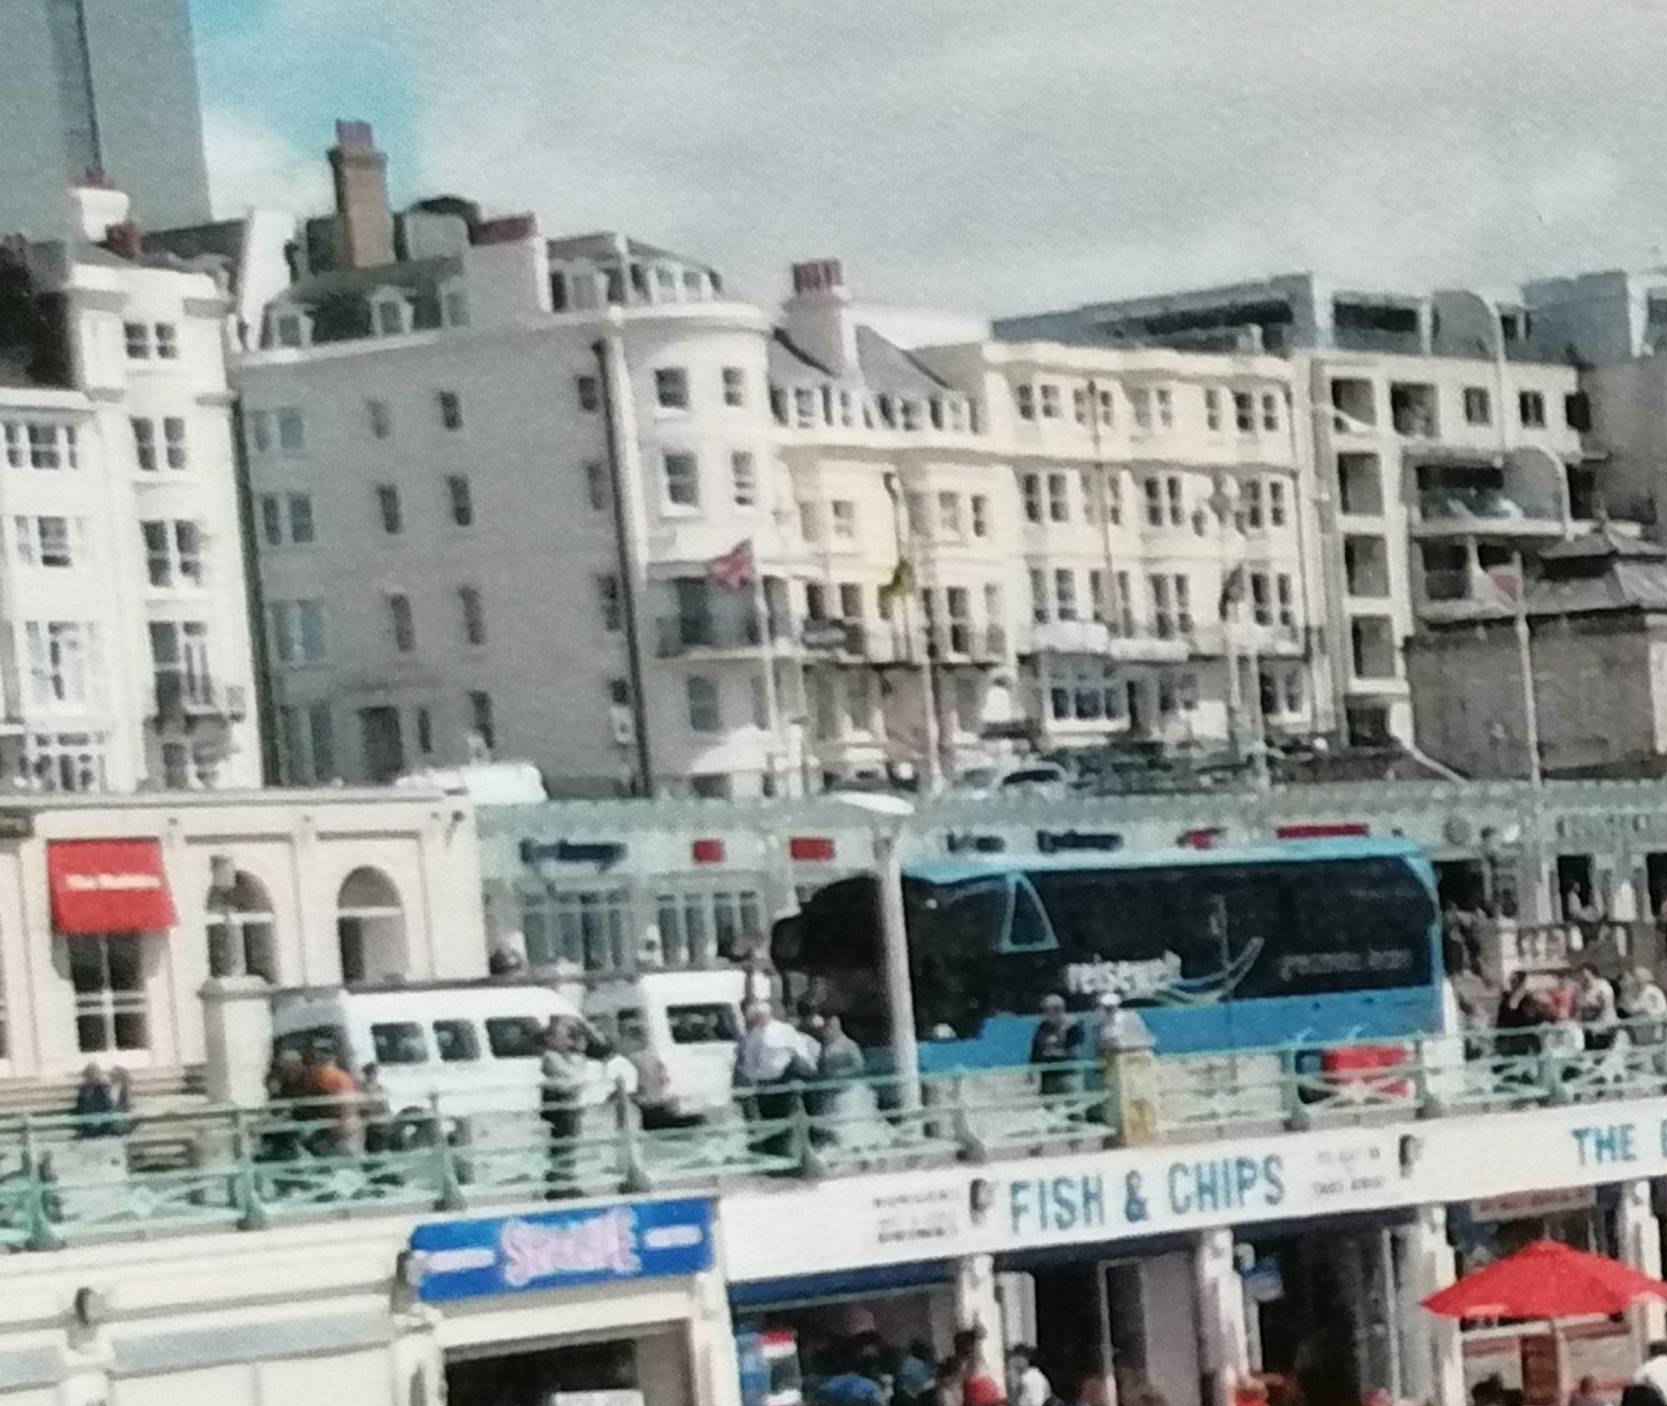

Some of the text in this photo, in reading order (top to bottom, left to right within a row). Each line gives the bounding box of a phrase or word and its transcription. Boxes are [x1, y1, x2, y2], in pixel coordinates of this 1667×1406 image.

[1570, 1121, 1637, 1167] THE
[1008, 1152, 1286, 1236] FISH & CHIPS
